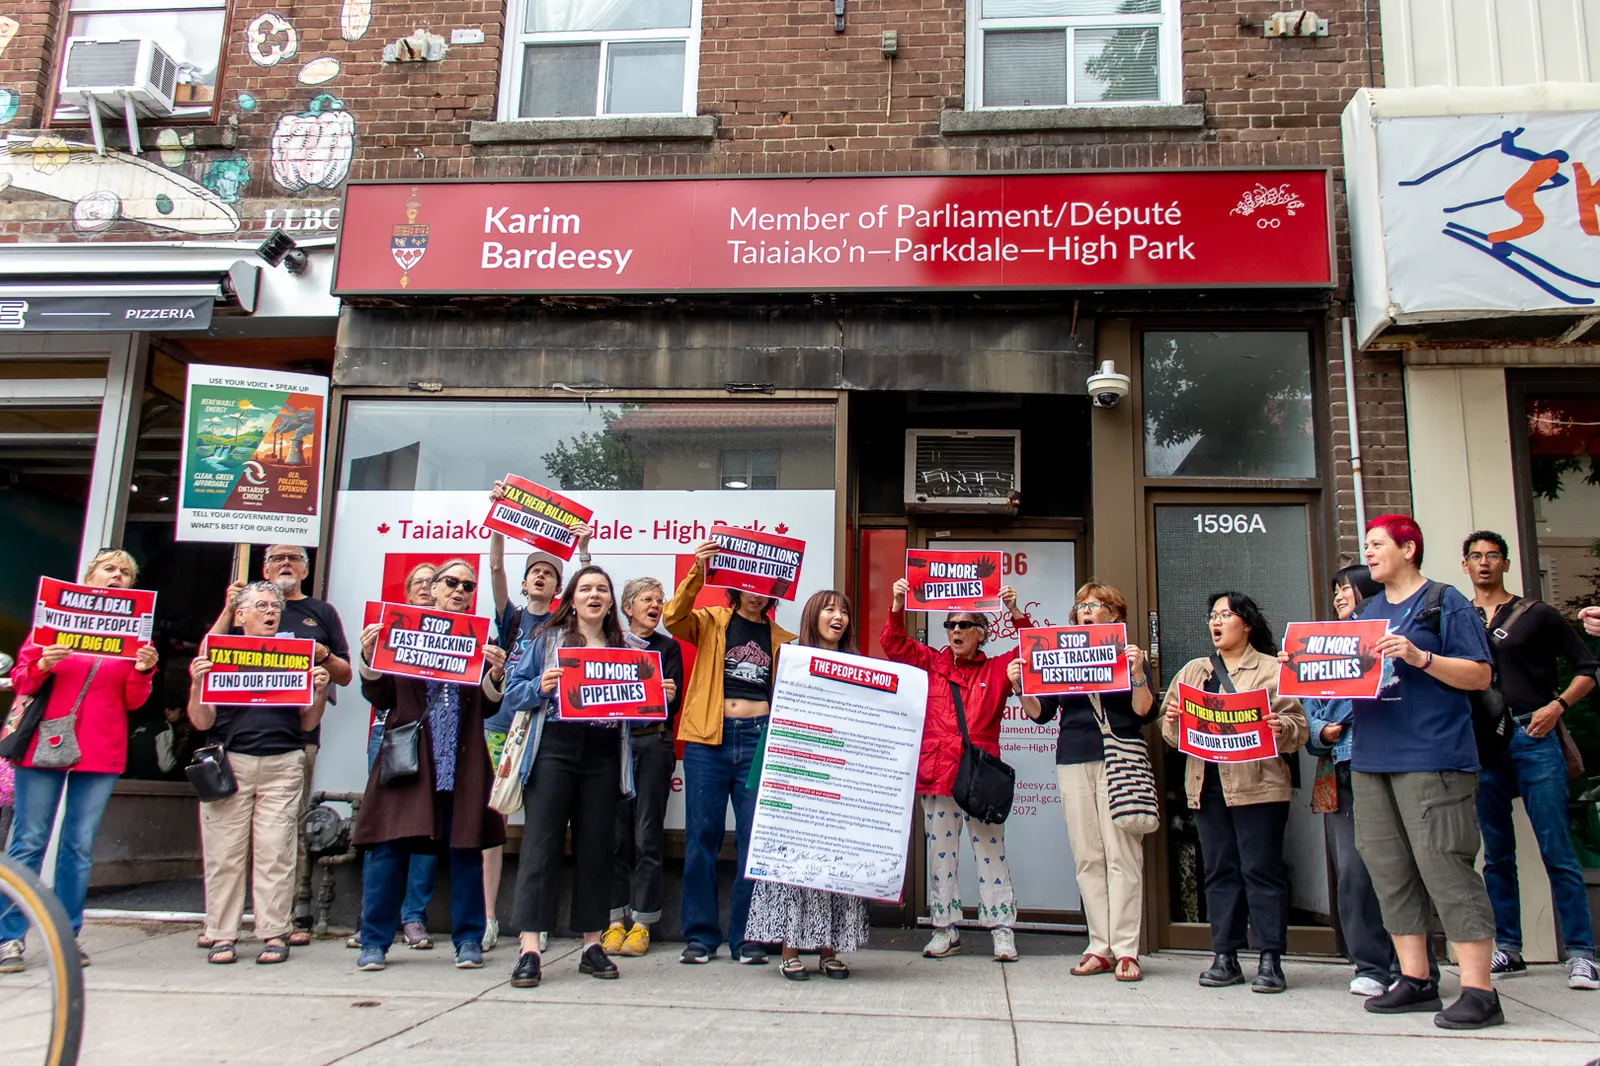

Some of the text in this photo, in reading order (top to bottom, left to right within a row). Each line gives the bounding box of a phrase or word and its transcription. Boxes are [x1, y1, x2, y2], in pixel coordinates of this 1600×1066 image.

[484, 206, 580, 234] Karim
[729, 200, 1182, 231] Member of Parliament/Député
[1129, 234, 1196, 261] Park
[481, 241, 633, 275] Bardeesy
[125, 308, 195, 319] PIZZERIA
[201, 398, 236, 407] RENEWABLE
[193, 480, 229, 488] AFFORDABLE
[215, 473, 235, 481] GREEN
[238, 486, 270, 494] ONTARIO'S
[243, 493, 264, 501] CHOICE
[278, 485, 308, 493] EXPENSIVE
[504, 485, 522, 502] TAX
[520, 493, 545, 513] THEIR
[232, 512, 284, 521] GOVERNMENT
[496, 506, 521, 524] FUND
[520, 516, 540, 531] OUR
[539, 522, 573, 544] FUTURE
[1193, 513, 1267, 534] 1596A
[274, 526, 308, 534] COUNTRY
[653, 520, 706, 544] High
[711, 534, 800, 566] TAX THEIR BILLIONS,
[712, 555, 794, 578] FUND OUR FUTURE
[930, 562, 978, 579] NO MORE
[926, 582, 982, 598] PIPELINES
[61, 591, 132, 615] MAKE A DEAL
[45, 610, 139, 633] WITH THE PEOPLE
[422, 617, 451, 634] STOP
[56, 632, 122, 653] NOT BIG OIL
[393, 631, 473, 653] FAST-TRACKING
[1060, 634, 1087, 648] STOP
[1306, 635, 1360, 655] NO MORE
[210, 649, 310, 670] TAX THEIR BILLIONS
[395, 647, 467, 673] DESTRUCTION
[1036, 647, 1114, 667] FAST-TRACKING
[585, 661, 638, 681] NO MORE
[814, 659, 892, 688] THE PEOPLE'S MOU
[1042, 667, 1112, 682] DESTRUCTION
[1300, 658, 1360, 681] PIPELINES
[212, 674, 304, 688] FUND OUR FUTURE
[582, 684, 644, 703] PIPELINES
[1185, 700, 1258, 723] TAX THEIR BILLIONS
[1189, 731, 1258, 748] FUND OUR FUTURE
[1012, 806, 1037, 815] 5072
